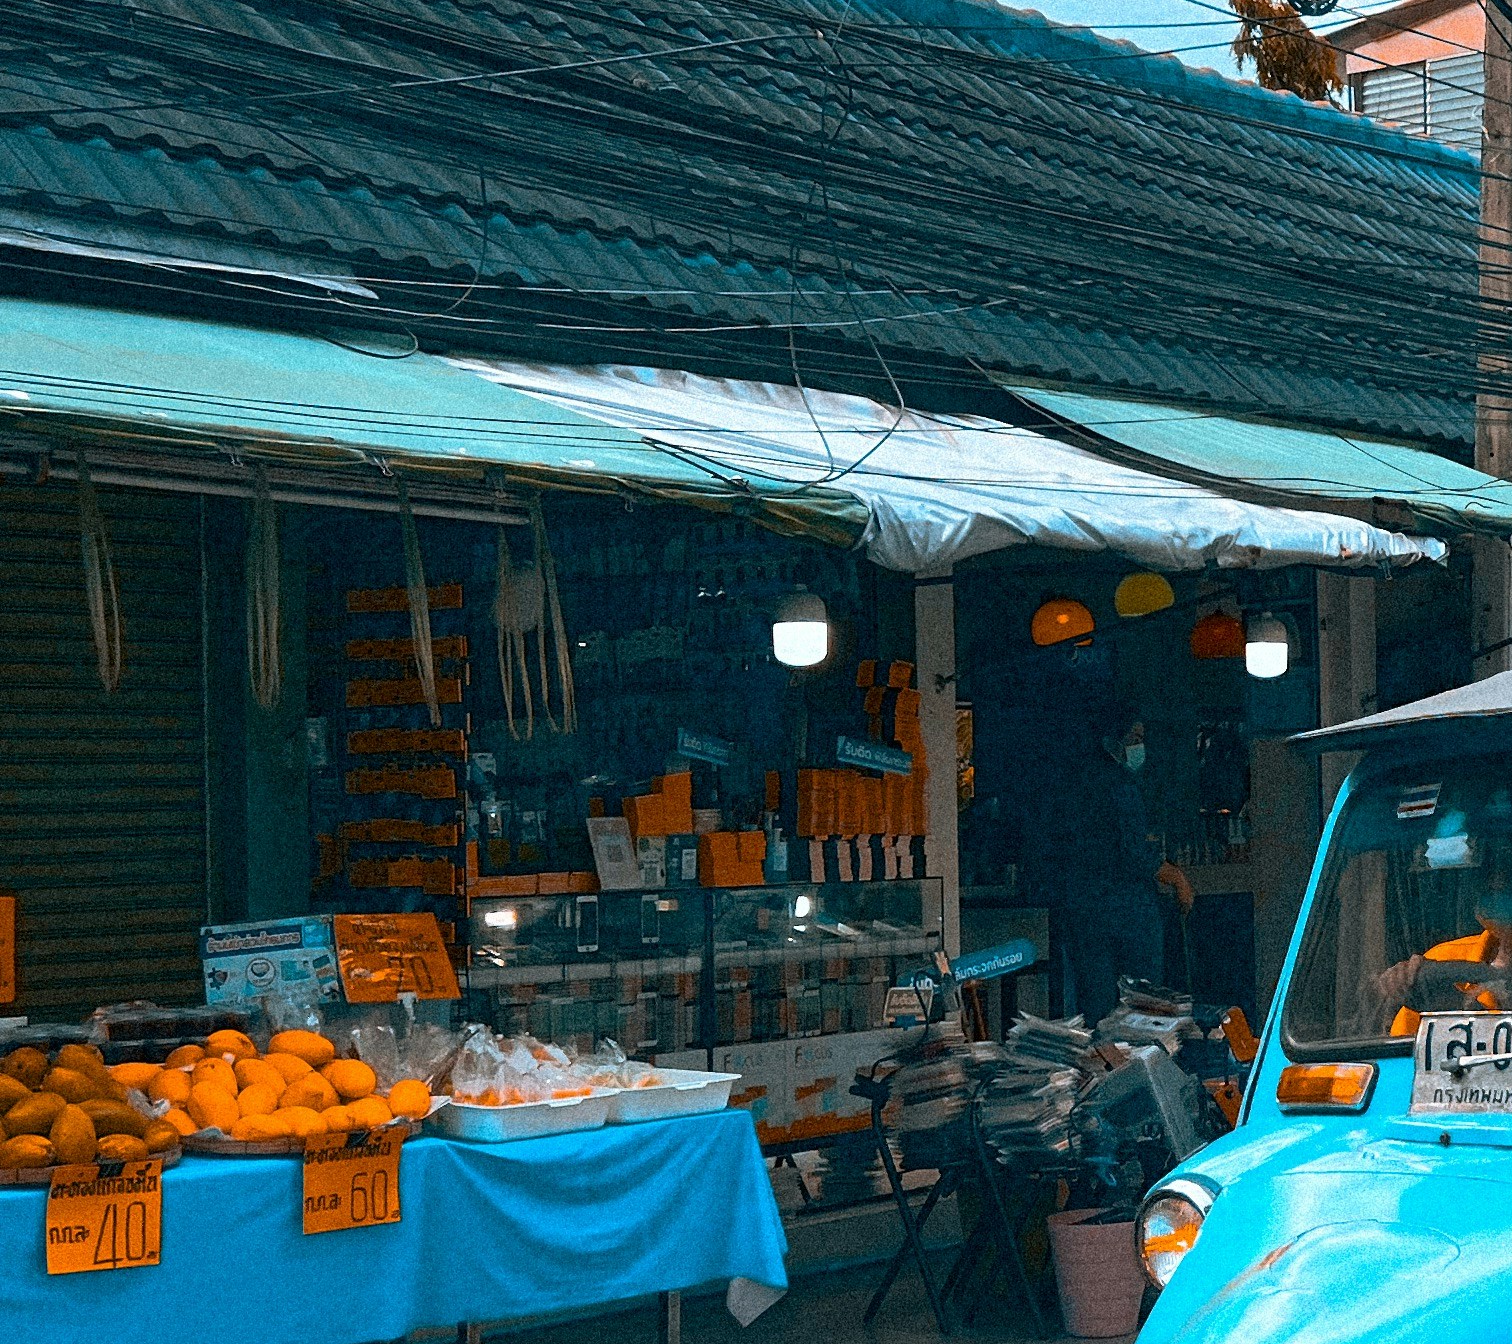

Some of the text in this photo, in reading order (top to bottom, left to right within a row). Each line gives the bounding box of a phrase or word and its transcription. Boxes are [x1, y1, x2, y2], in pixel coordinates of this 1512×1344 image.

[955, 951, 1023, 982] ล์มกระจกกันรอย
